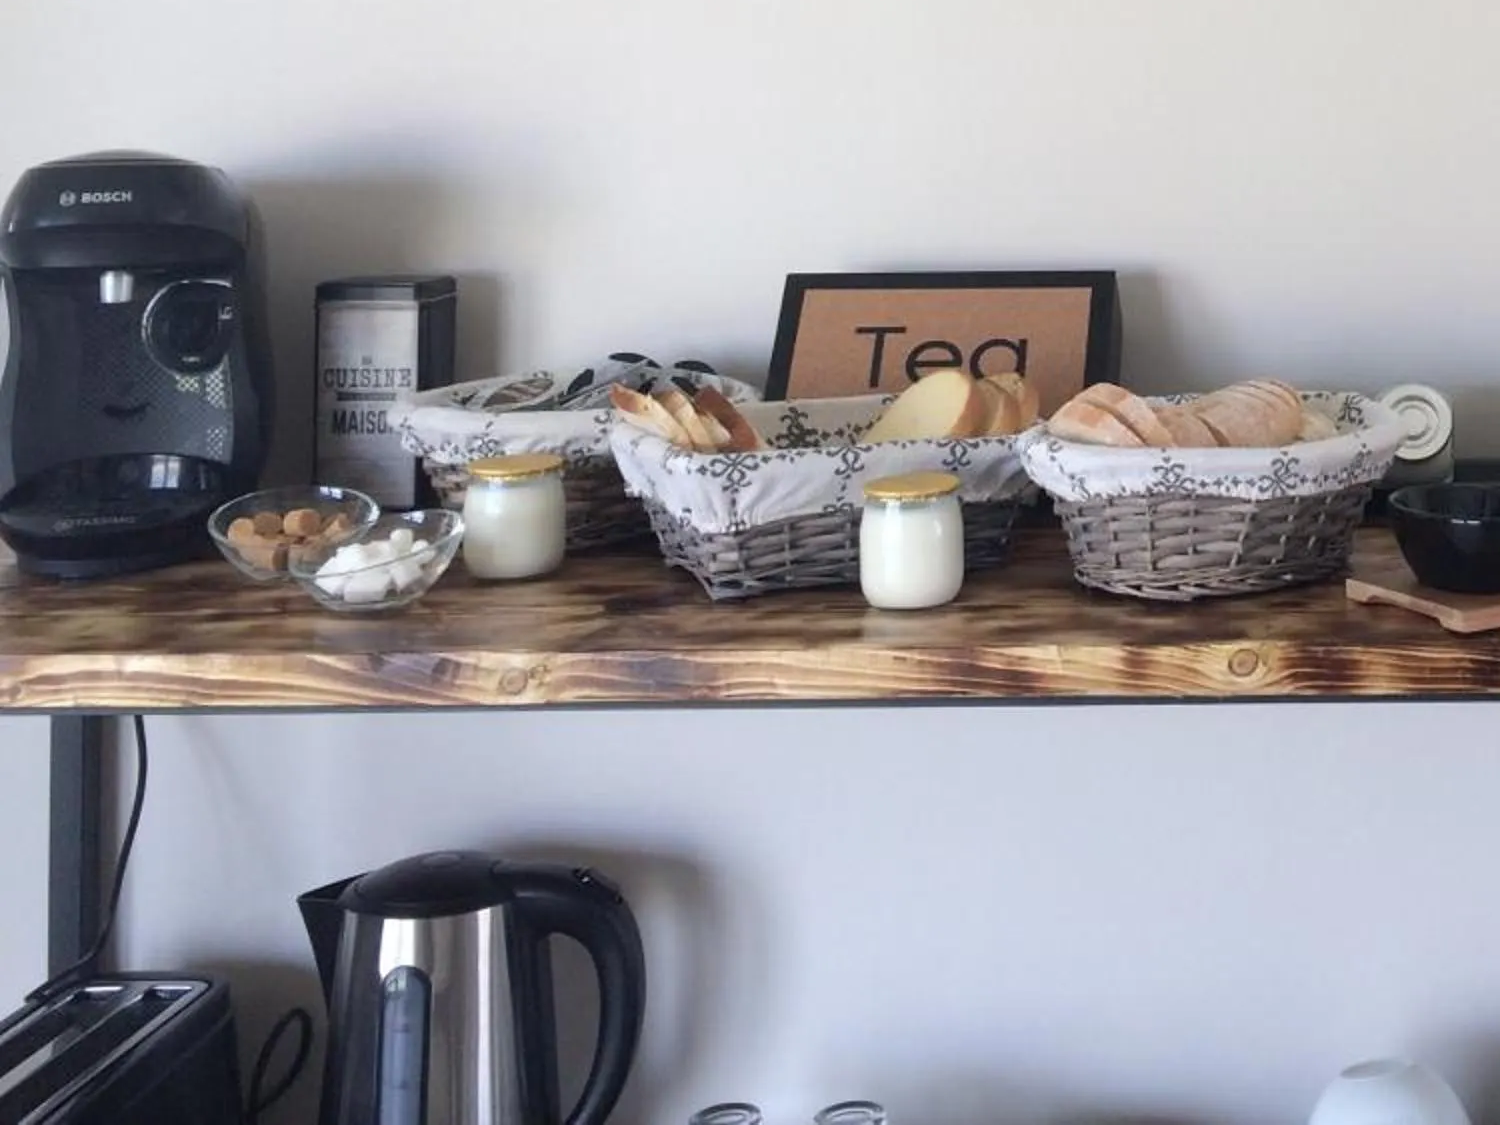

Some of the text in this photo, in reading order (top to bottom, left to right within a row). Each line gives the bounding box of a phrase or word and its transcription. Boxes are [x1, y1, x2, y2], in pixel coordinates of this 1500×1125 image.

[81, 191, 132, 204] BOSCH
[856, 326, 1028, 388] Tea
[322, 367, 412, 389] CUISINE
[332, 408, 394, 435] MAISO
